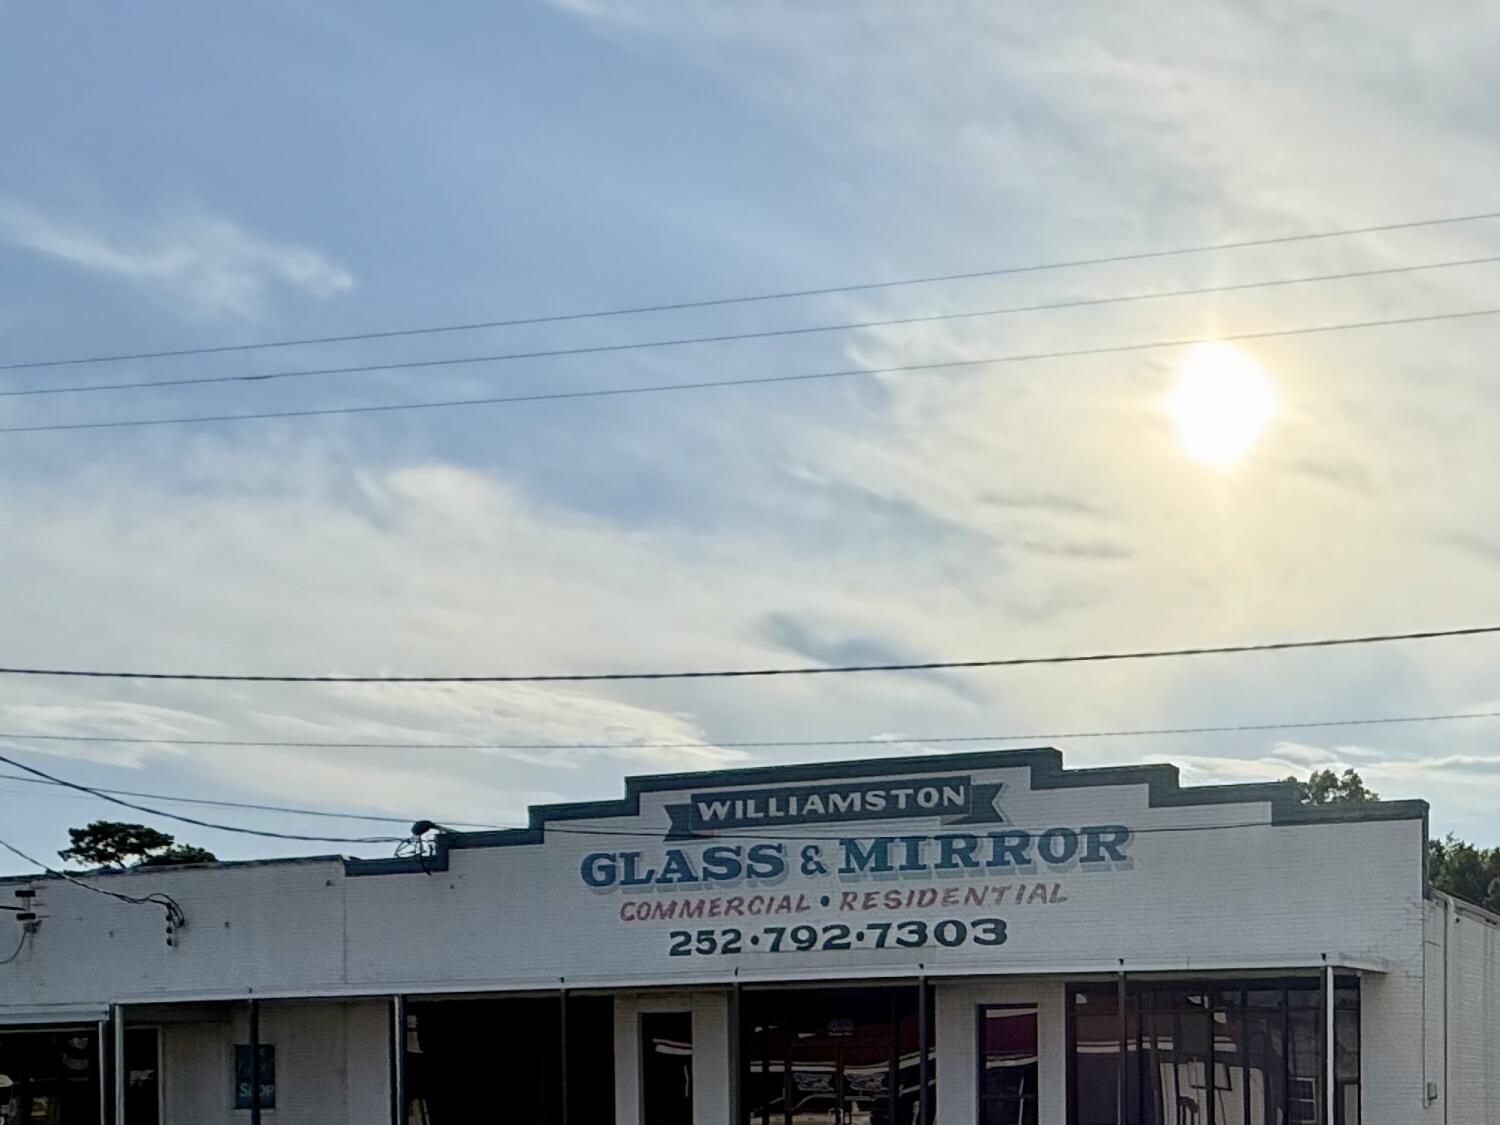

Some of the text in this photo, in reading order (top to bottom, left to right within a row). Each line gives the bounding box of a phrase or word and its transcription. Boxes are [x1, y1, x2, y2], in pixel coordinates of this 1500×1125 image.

[696, 785, 965, 822] WILLIAMSTON
[580, 825, 1131, 889] GLASS & MIRROR
[620, 883, 1069, 922] COMMERCIAL RESIDENTIAL
